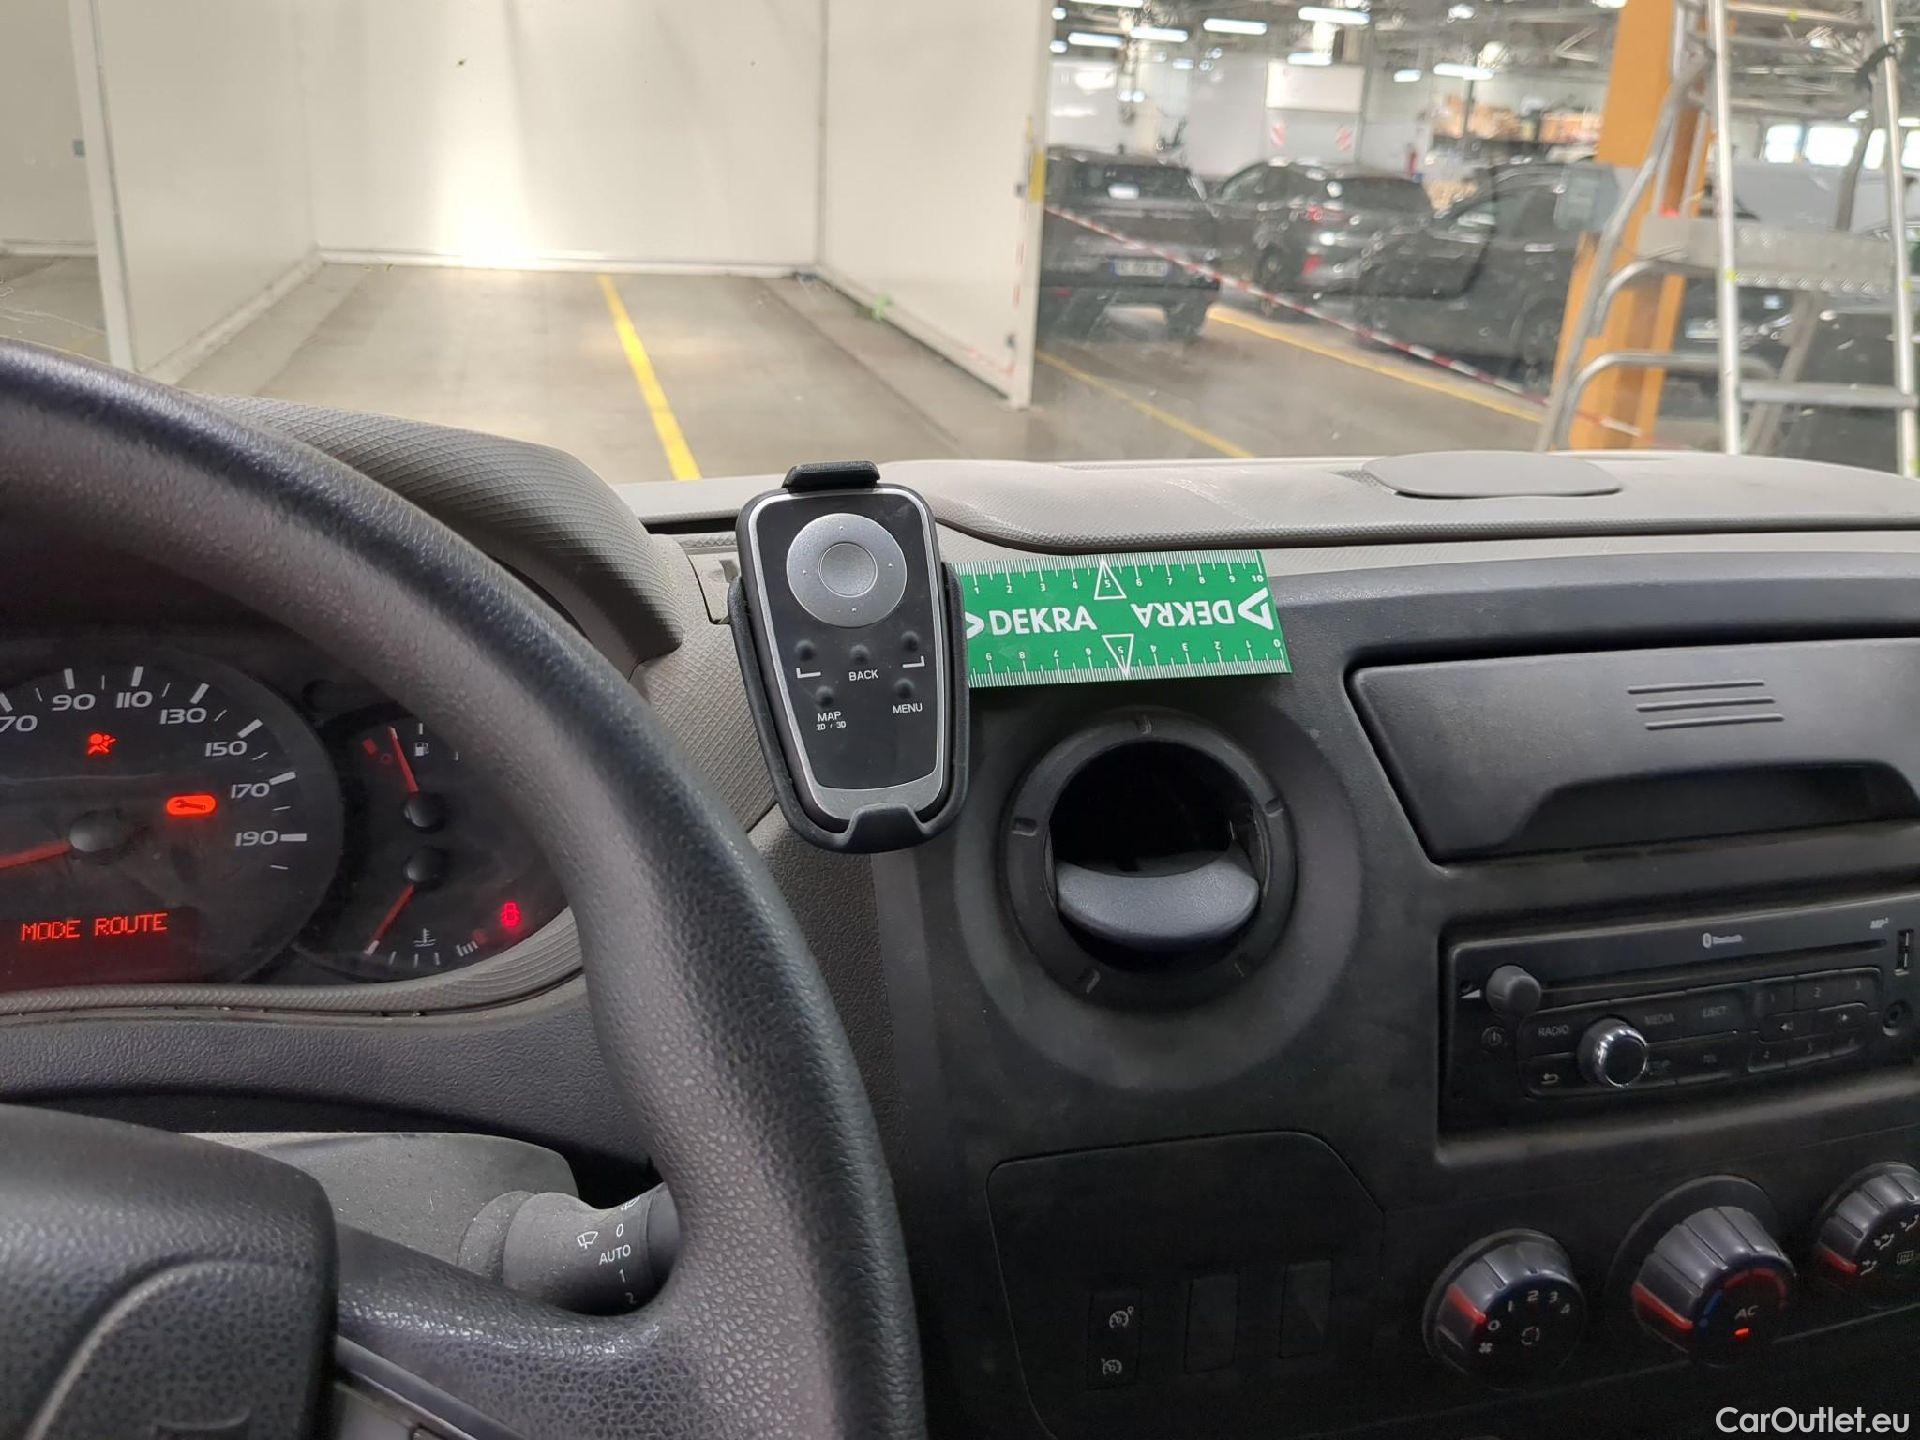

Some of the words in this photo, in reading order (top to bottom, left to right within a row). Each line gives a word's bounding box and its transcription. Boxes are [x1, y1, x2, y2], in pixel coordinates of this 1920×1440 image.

[974, 587, 980, 595] 1
[1006, 585, 1013, 594] 2
[1040, 583, 1046, 592] 3
[1072, 581, 1079, 590] 4
[1104, 579, 1111, 589] 5
[1135, 577, 1143, 587] 6
[1166, 577, 1173, 586] 7
[1199, 576, 1206, 585] 8
[1229, 575, 1236, 584] 9
[1251, 574, 1264, 583] 10
[989, 605, 1098, 636] DEKRA
[1130, 600, 1236, 629] DEKRA
[1117, 645, 1124, 654] 5
[1150, 644, 1157, 653] 4
[1182, 642, 1189, 652] 3
[1214, 641, 1222, 650] 2
[1245, 639, 1252, 649] 1
[1273, 638, 1281, 648] 0
[985, 652, 993, 661] 9
[1018, 651, 1026, 660] 8
[1053, 650, 1060, 658] 7
[1085, 648, 1091, 656] 6
[848, 669, 879, 682] BACK
[52, 693, 96, 712] 90
[115, 691, 153, 709] 110
[159, 707, 207, 725] 130
[892, 703, 923, 714] MENU
[0, 715, 38, 733] 70
[817, 711, 842, 722] MAP
[204, 740, 248, 757] 150
[231, 782, 270, 799] 170
[235, 830, 279, 847] 190
[20, 919, 81, 942] MODE
[94, 912, 168, 937] ROUTE
[1538, 1024, 1569, 1037] RADIO
[616, 1223, 624, 1238] 0
[599, 1244, 631, 1266] AUTO
[619, 1268, 626, 1283] 1
[1488, 1320, 1500, 1331] 0
[1508, 1300, 1513, 1312] 1
[1527, 1290, 1539, 1302] 2
[1549, 1291, 1558, 1303] 3
[1734, 1305, 1759, 1320] AC
